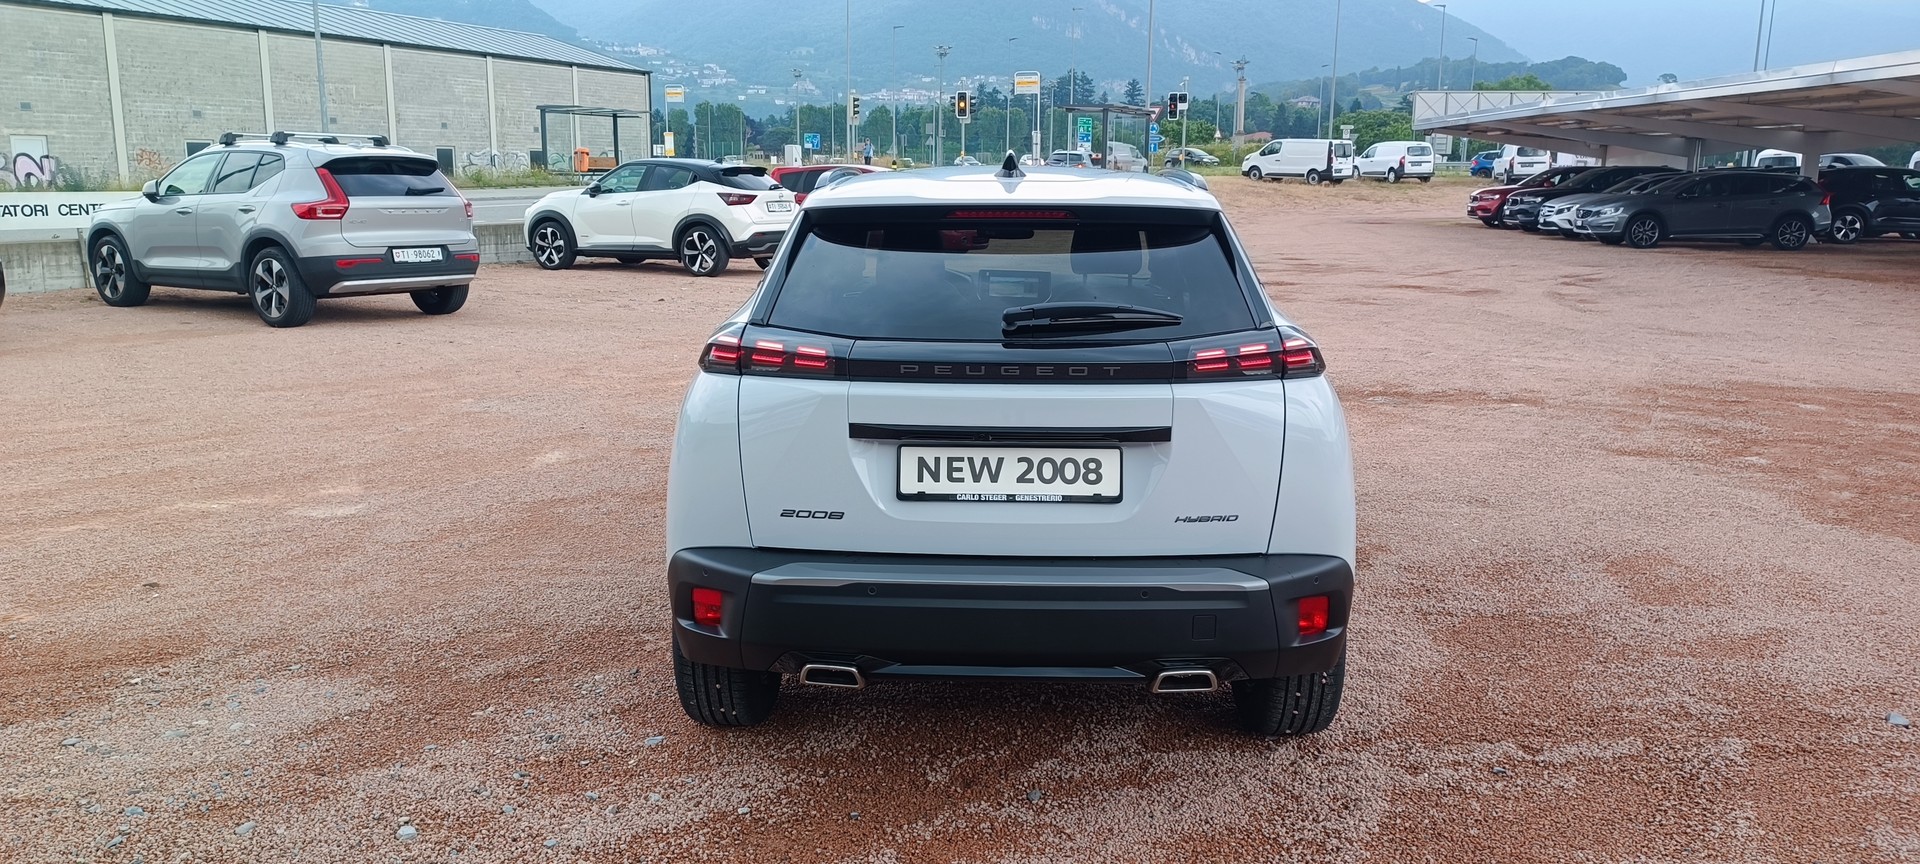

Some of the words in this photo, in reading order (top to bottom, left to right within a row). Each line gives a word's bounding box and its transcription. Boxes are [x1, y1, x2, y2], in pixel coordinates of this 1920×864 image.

[900, 365, 1121, 376] PEUGEOT
[917, 456, 1005, 484] NEW
[1016, 456, 1104, 486] 2008
[956, 493, 979, 501] CARLO
[1015, 494, 1062, 502] GENESTRERIO
[780, 509, 845, 520] 2008
[1174, 514, 1239, 523] HYBRID
